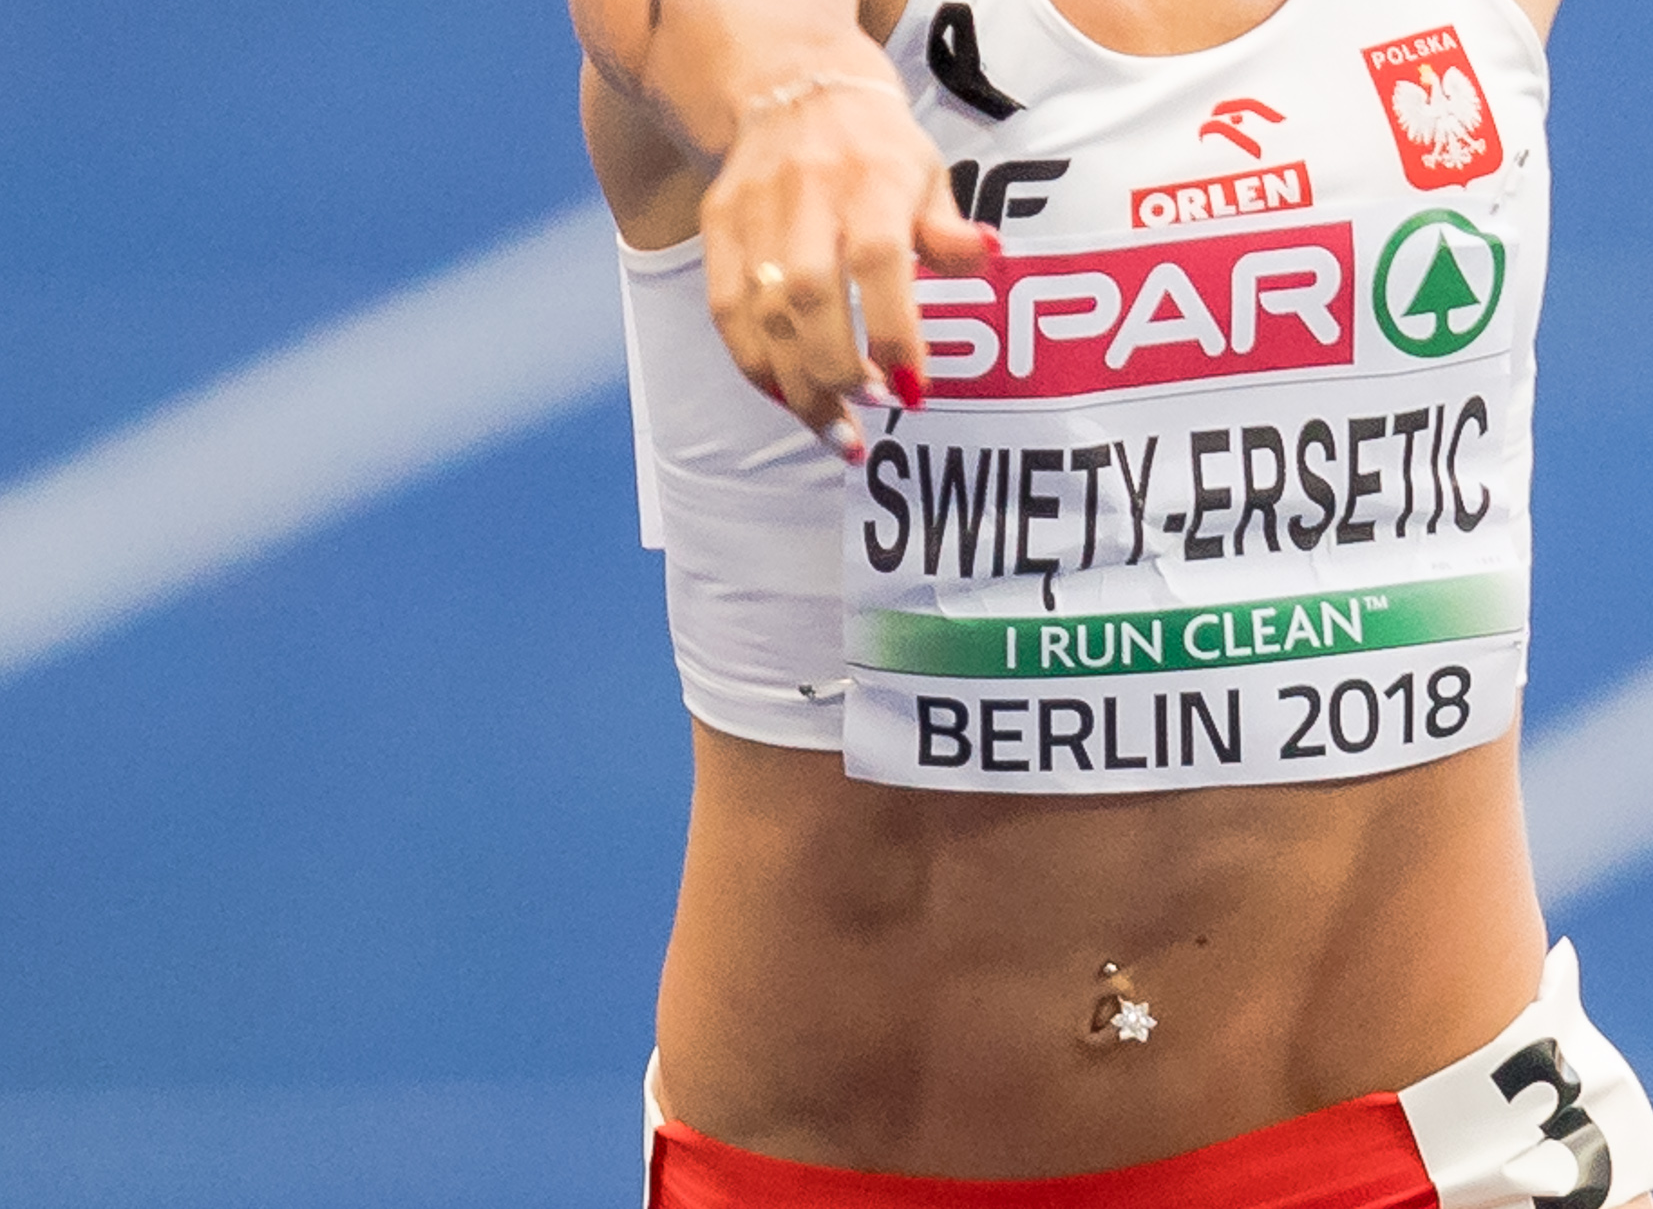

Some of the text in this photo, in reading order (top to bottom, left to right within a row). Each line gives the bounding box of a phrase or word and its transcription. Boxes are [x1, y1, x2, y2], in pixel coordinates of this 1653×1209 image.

[1370, 31, 1458, 70] POLSKA
[1138, 168, 1301, 229] ORLEN
[913, 245, 1342, 379] SPAR
[863, 394, 1492, 610] ŚWIĘTY-ERSETIC
[1006, 626, 1017, 670] I
[1041, 619, 1163, 669] RUN
[916, 665, 1472, 773] BERLIN 2018
[1490, 1036, 1612, 1209] 3
